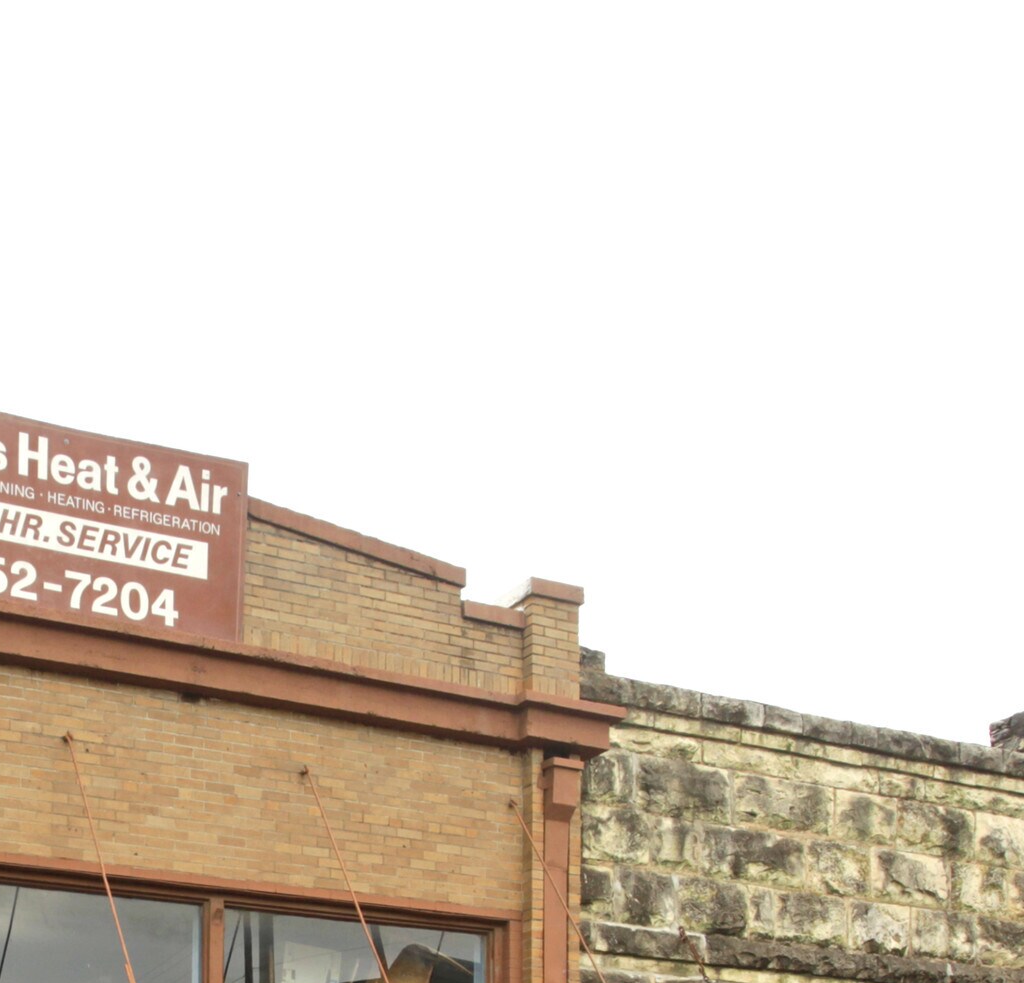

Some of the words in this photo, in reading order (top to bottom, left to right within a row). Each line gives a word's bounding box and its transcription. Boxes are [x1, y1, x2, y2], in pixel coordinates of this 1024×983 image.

[17, 431, 119, 496] Heat
[127, 456, 160, 503] &
[165, 464, 228, 515] Air
[47, 490, 105, 515] HEATING
[113, 504, 221, 536] REFRIGERATION
[56, 521, 193, 570] SERVICE
